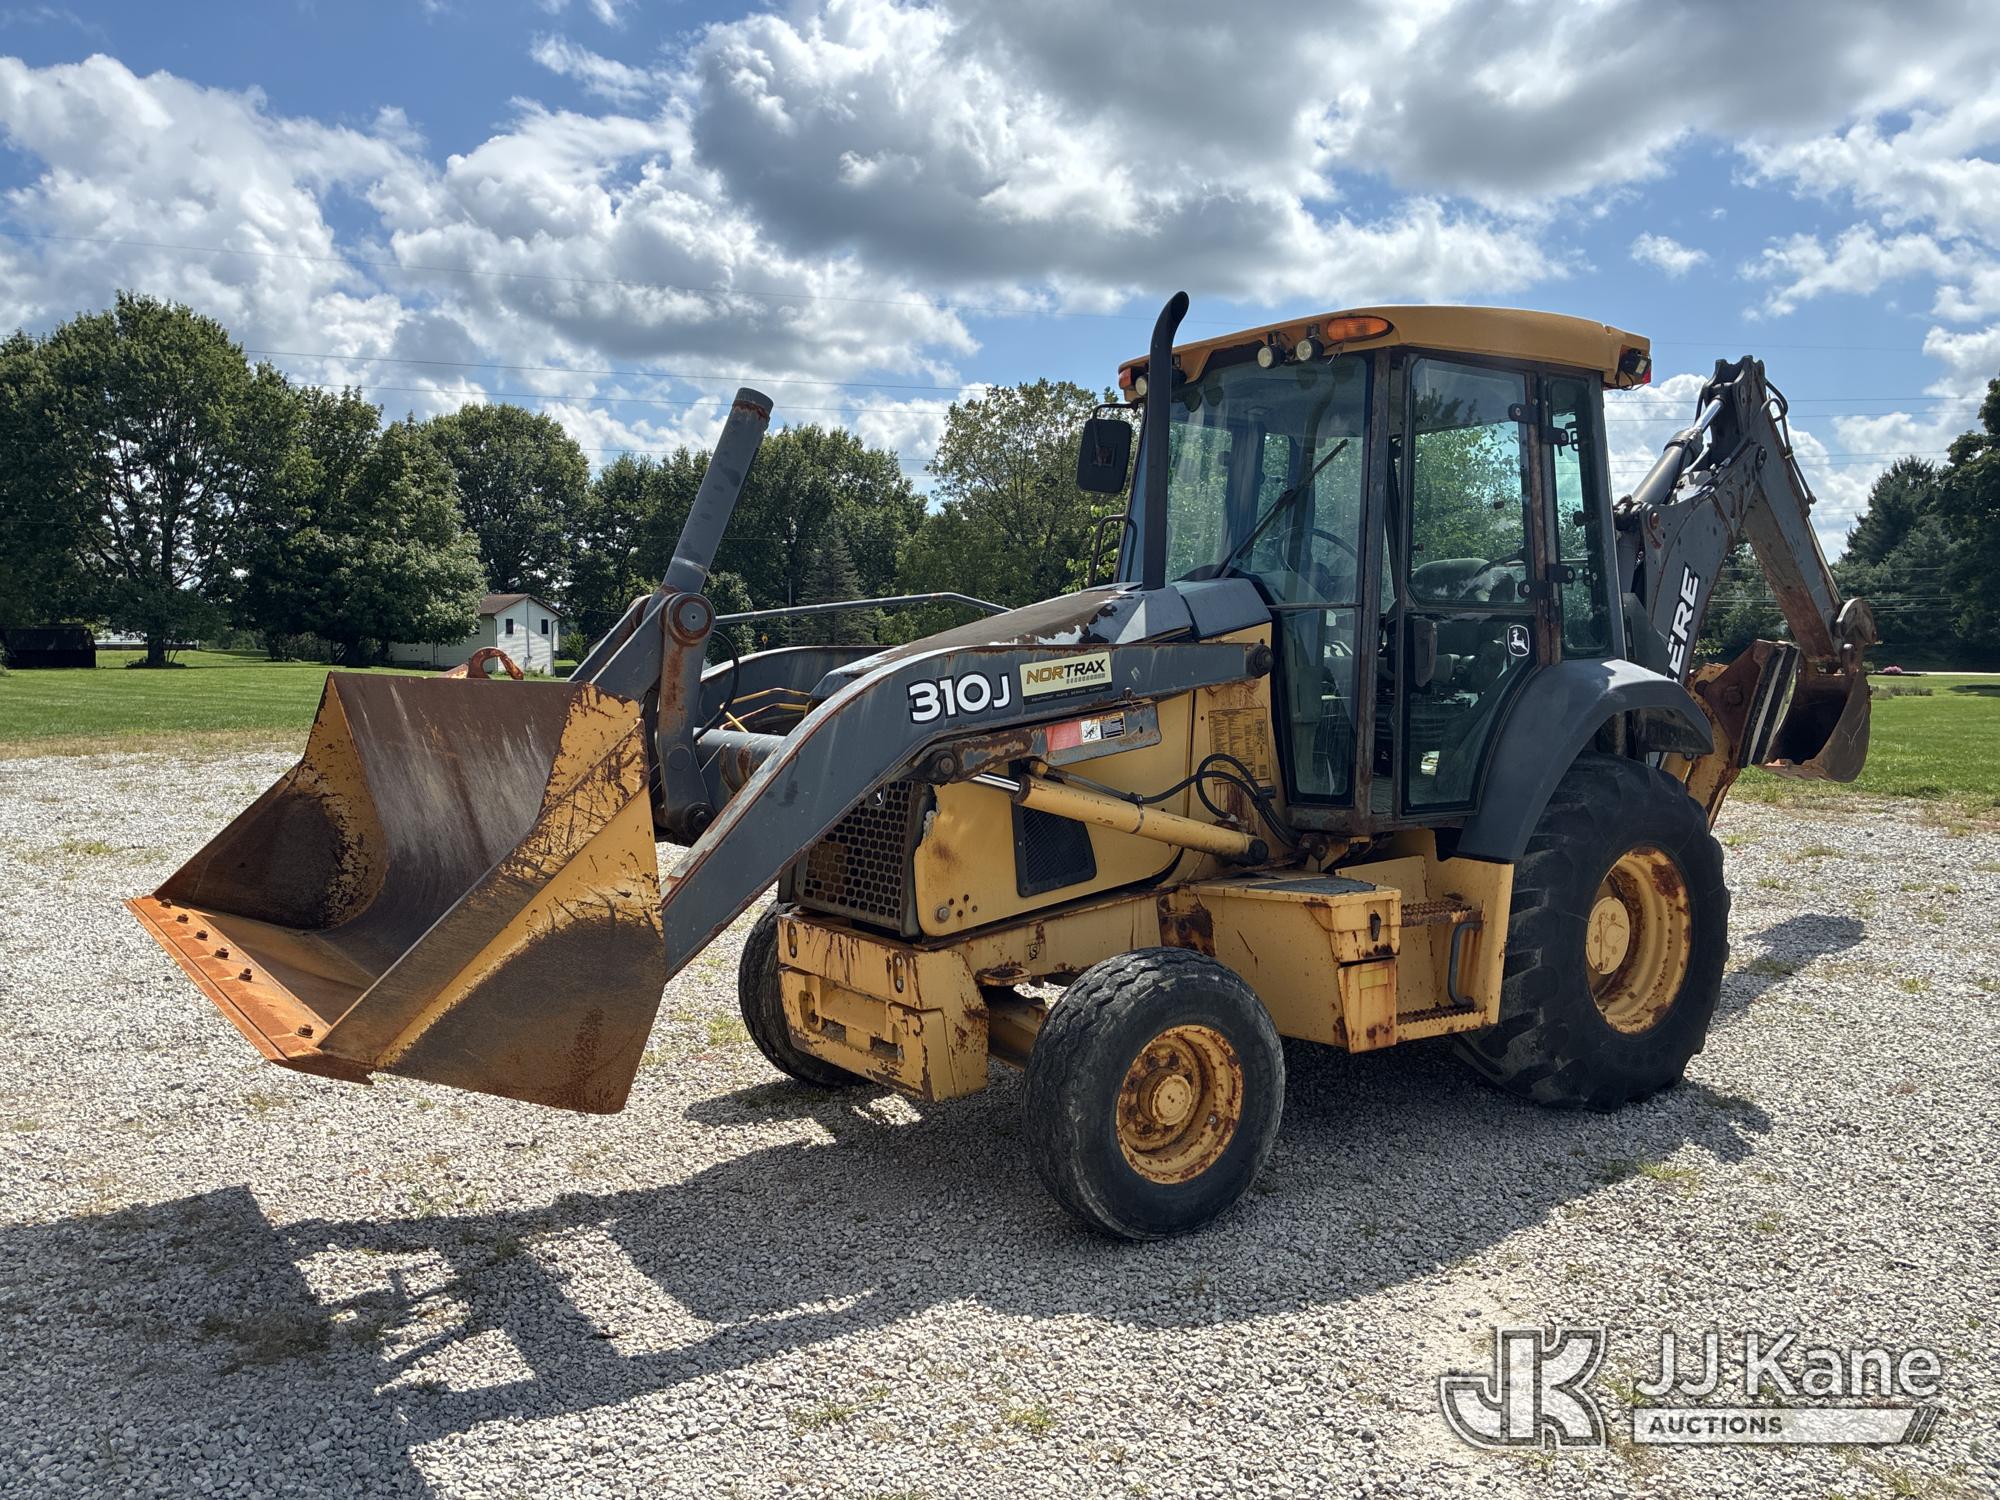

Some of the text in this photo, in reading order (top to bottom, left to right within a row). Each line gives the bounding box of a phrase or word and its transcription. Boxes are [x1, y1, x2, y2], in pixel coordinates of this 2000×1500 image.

[1666, 566, 1699, 682] ERE
[1026, 659, 1105, 684] NORTRAX
[908, 673, 1011, 722] 310J
